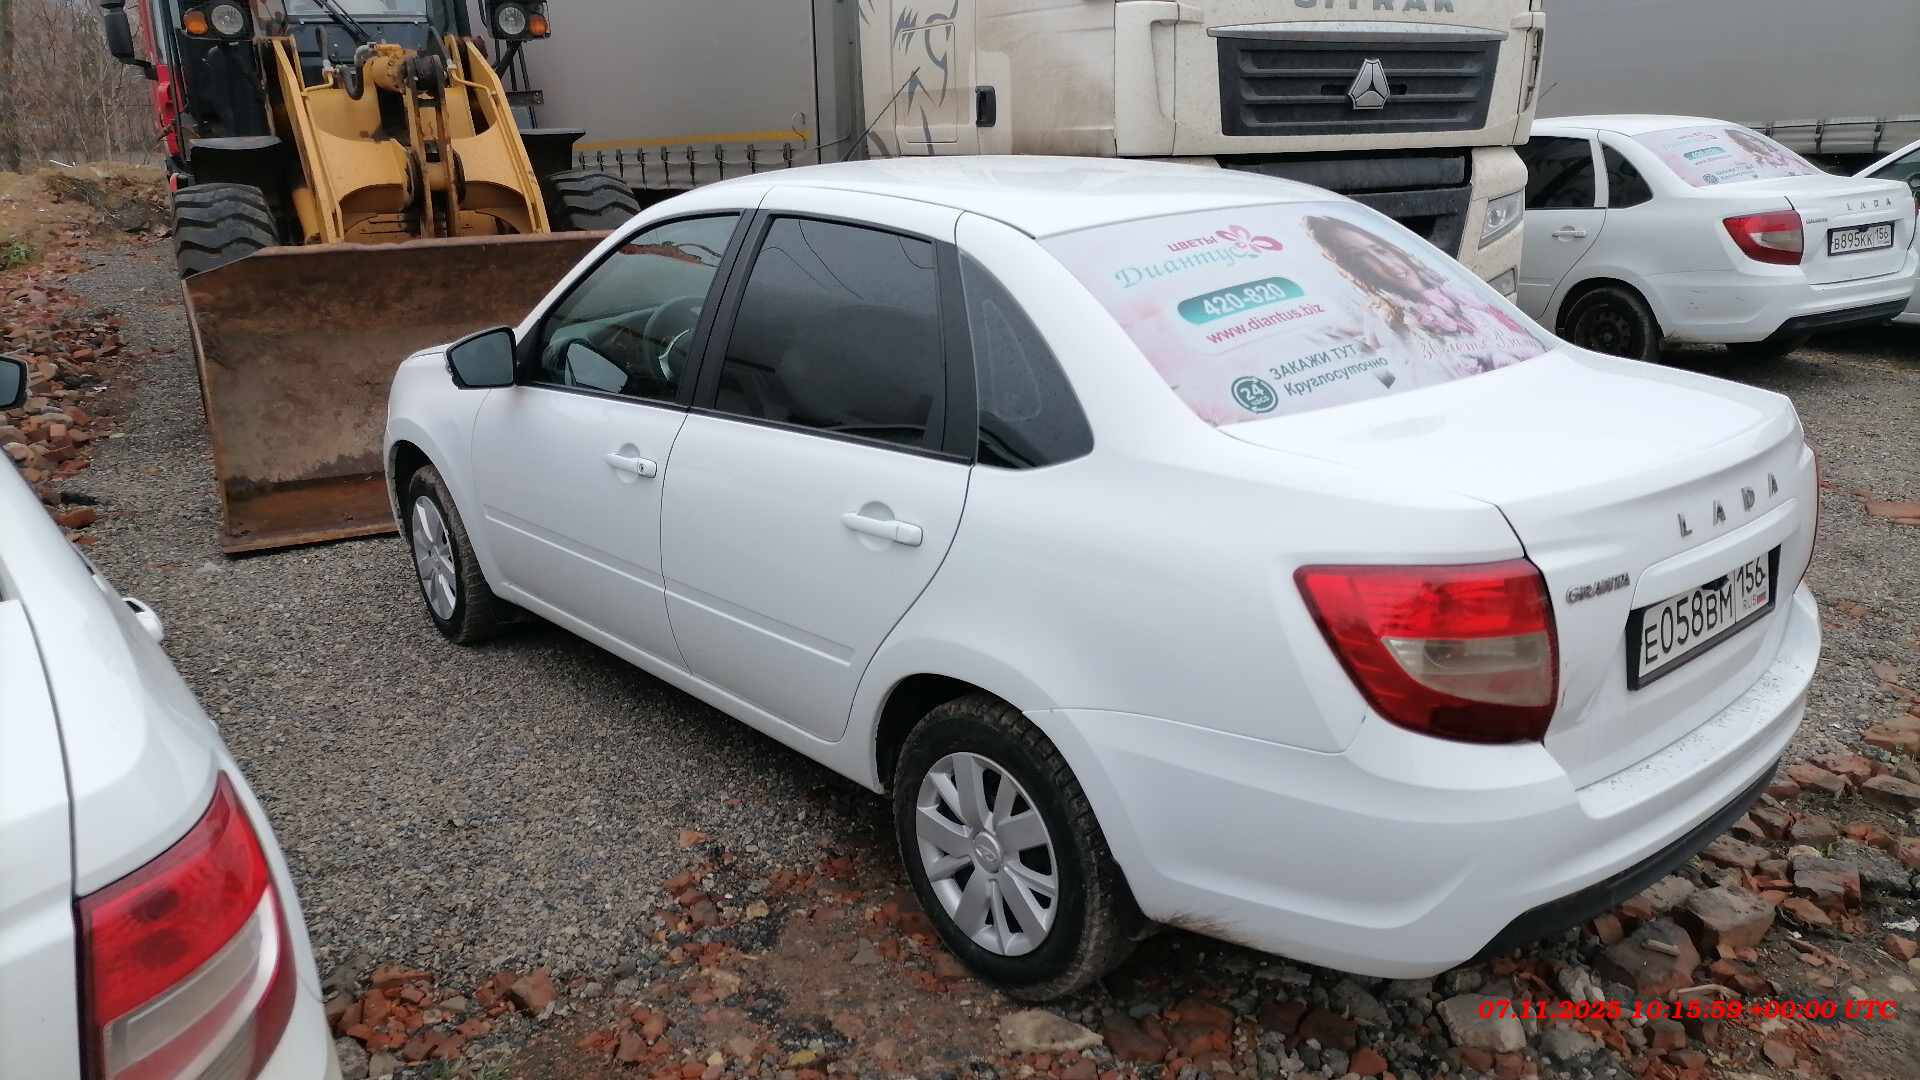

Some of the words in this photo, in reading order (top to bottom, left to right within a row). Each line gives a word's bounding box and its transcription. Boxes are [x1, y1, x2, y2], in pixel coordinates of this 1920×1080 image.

[1846, 198, 1892, 211] LADA
[1168, 236, 1218, 252] ЦВЕТЫ
[1876, 227, 1889, 240] 156
[1203, 283, 1287, 316] 420-820
[1206, 303, 1325, 344] www.diantus.biz
[1269, 351, 1333, 380] ЗАКАЖИ
[1330, 343, 1357, 360] ТУТ
[1284, 356, 1389, 397] Круглосуточно
[1240, 384, 1265, 401] 24
[1678, 473, 1778, 537] LADA
[1566, 571, 1630, 605] GRANTA
[1737, 556, 1766, 598] 156
